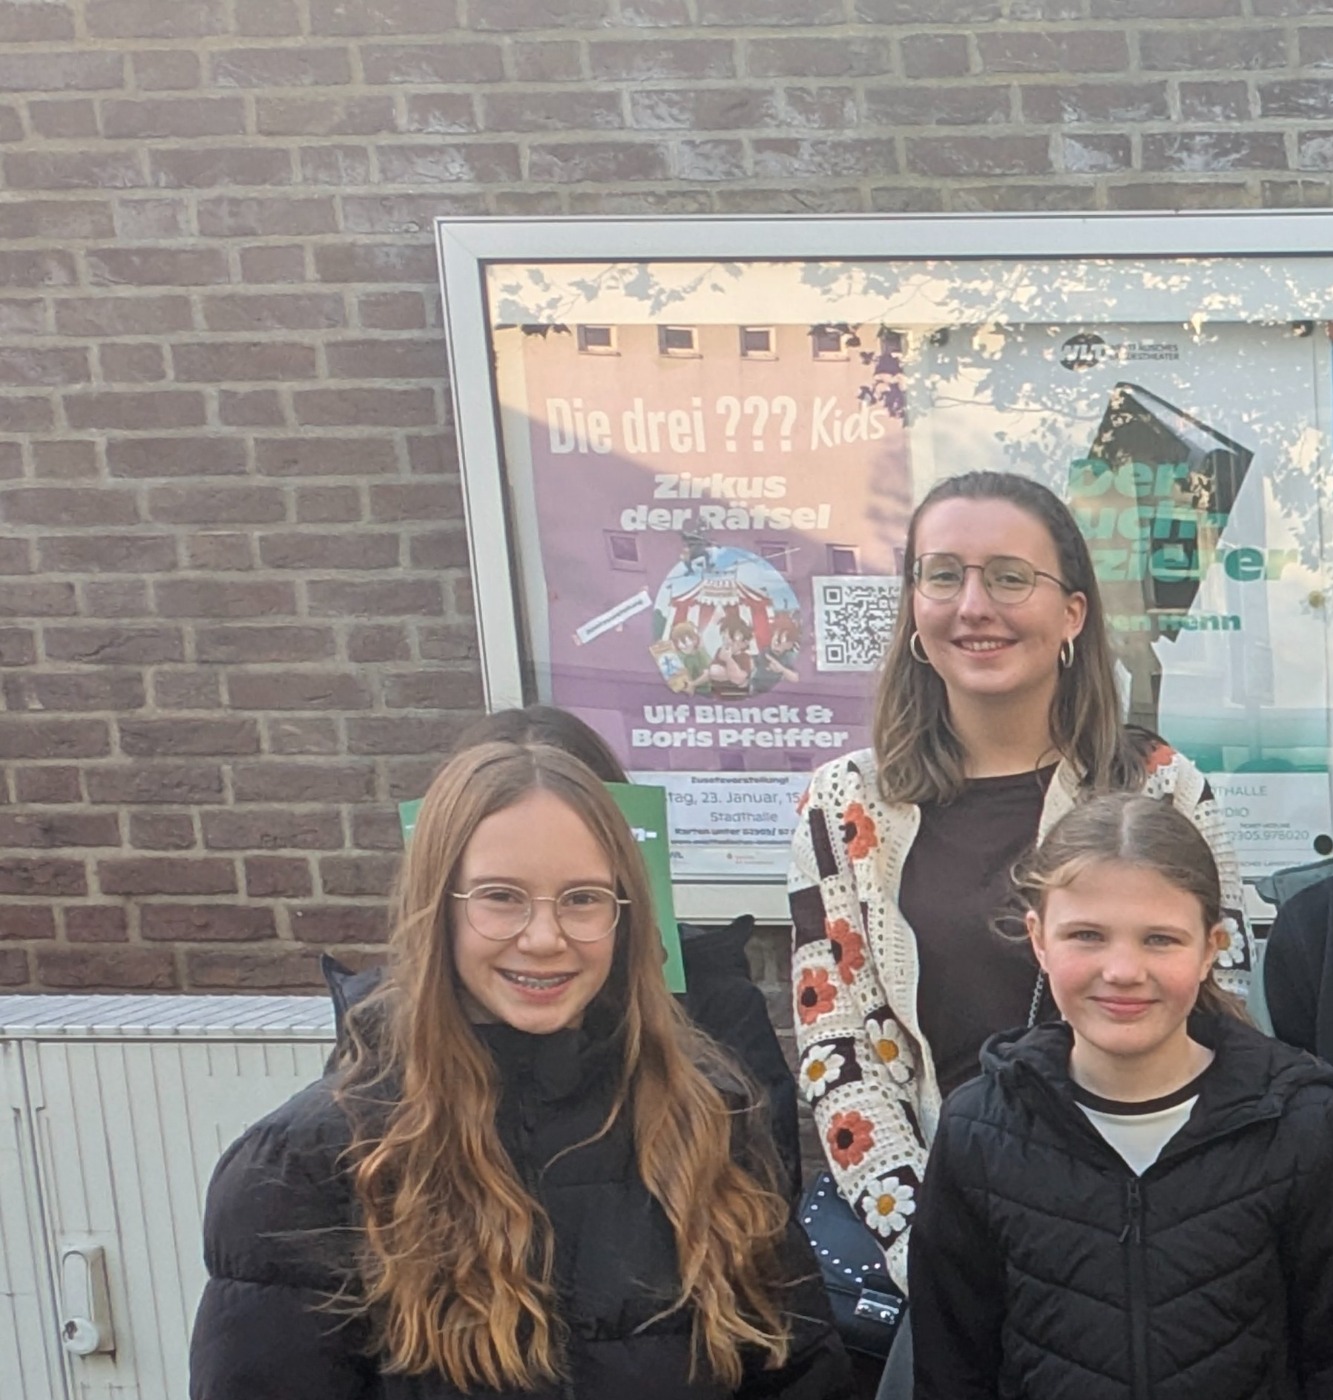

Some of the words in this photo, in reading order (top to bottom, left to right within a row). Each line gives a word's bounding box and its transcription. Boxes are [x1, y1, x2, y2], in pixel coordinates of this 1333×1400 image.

[545, 398, 613, 454] Die
[621, 396, 706, 453] drei
[716, 395, 797, 453] ???
[810, 396, 888, 451] Kids
[653, 472, 787, 499] Zirkus
[1067, 458, 1190, 498] Der
[620, 504, 692, 531] der
[699, 502, 832, 530] Rätsel
[1074, 499, 1229, 540] uch-
[1092, 541, 1300, 583] zierer
[643, 704, 690, 724] Ulf
[694, 704, 801, 724] Blanck
[805, 704, 834, 724] &
[632, 728, 713, 747] Boris
[718, 728, 849, 747] Pfeiffer
[701, 791, 722, 804] 23.
[727, 791, 783, 806] Januar,
[709, 811, 779, 823] Stadthalle
[1229, 830, 1309, 841] 2305.978020
